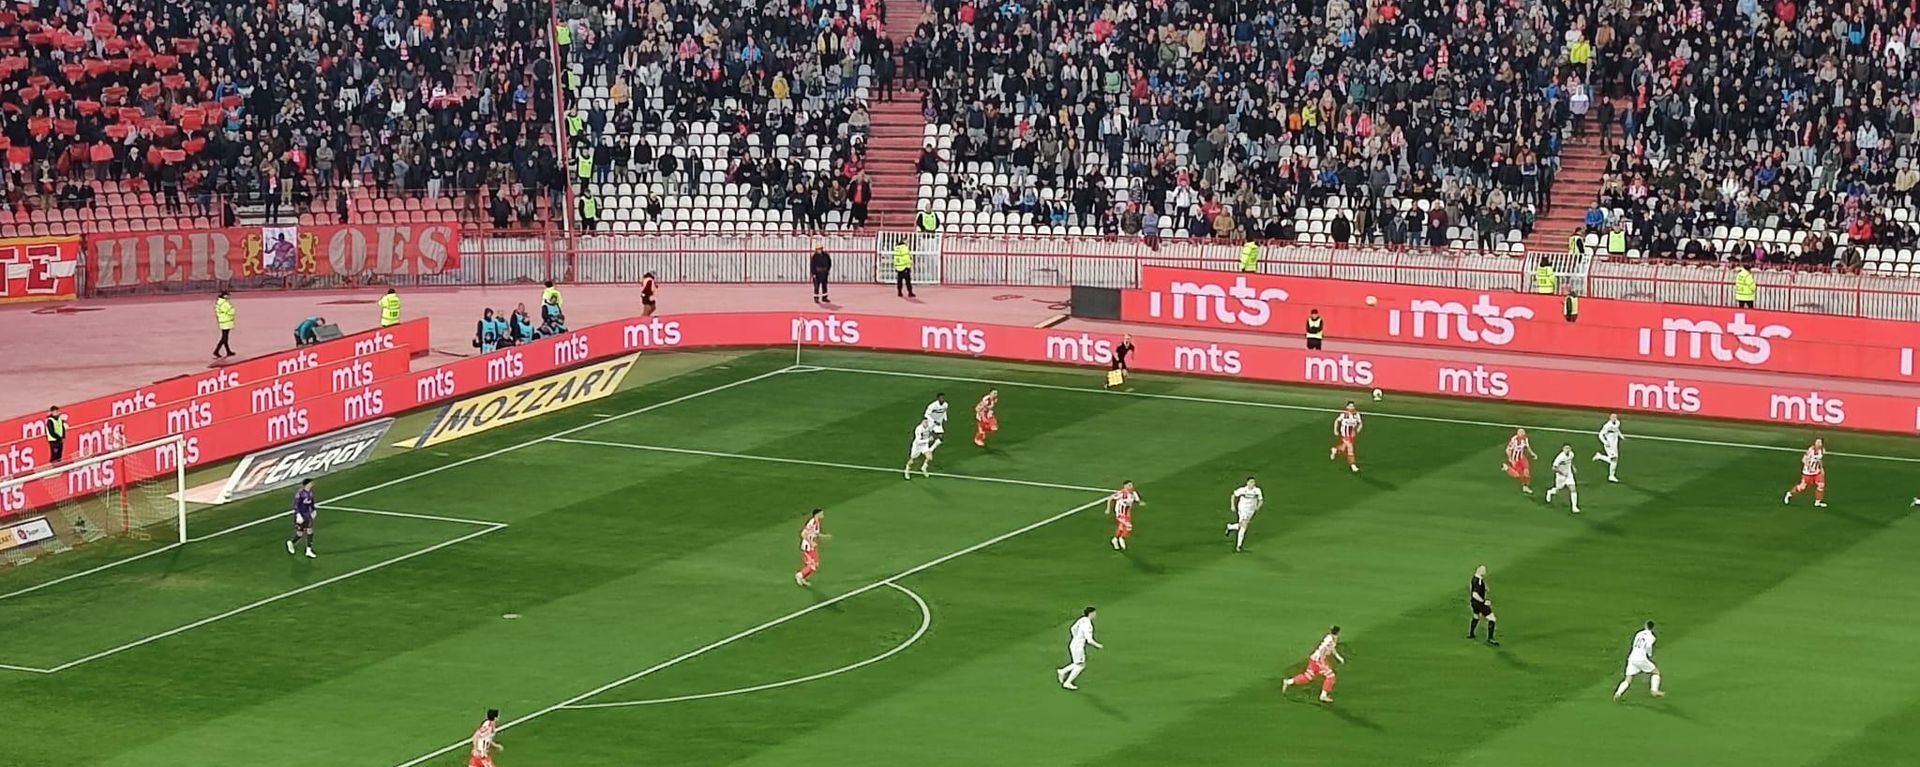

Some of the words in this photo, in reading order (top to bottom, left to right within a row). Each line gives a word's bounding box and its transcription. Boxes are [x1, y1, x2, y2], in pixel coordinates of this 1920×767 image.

[95, 232, 232, 288] HER
[328, 223, 452, 277] OES
[167, 399, 213, 434] mts
[251, 378, 296, 413] mts
[332, 357, 375, 393] mts
[267, 405, 310, 442] mts
[343, 386, 384, 422] mts
[417, 367, 456, 402] mts
[487, 349, 524, 384] mts
[554, 333, 589, 365] mts
[623, 315, 682, 349] mts
[790, 314, 861, 344] mts
[921, 322, 986, 353] mts
[1046, 332, 1113, 363] mts
[1174, 343, 1242, 375] mts
[1305, 353, 1375, 386] mts
[1438, 364, 1510, 397] mts
[1627, 379, 1702, 413] mts
[1770, 390, 1846, 425] mts
[434, 361, 632, 438] MOZZART
